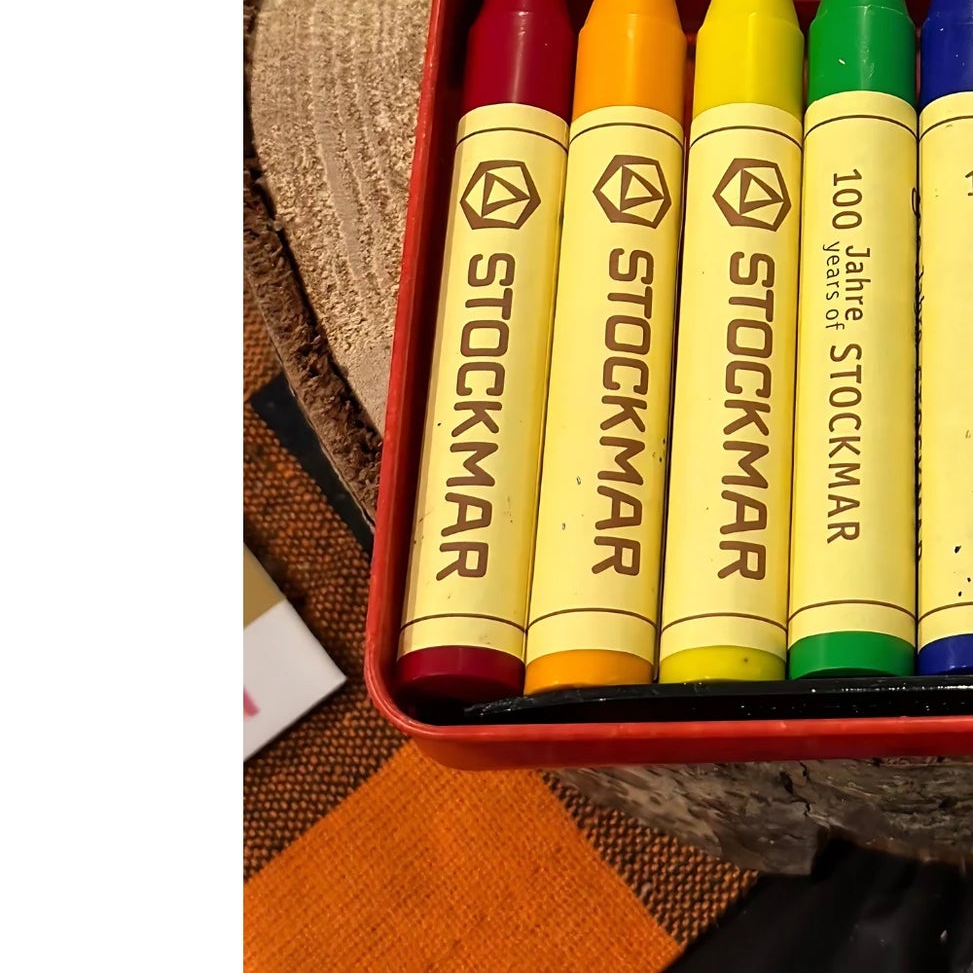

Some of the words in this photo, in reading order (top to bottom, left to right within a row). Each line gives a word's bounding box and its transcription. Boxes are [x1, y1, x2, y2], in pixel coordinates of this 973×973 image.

[831, 168, 863, 230] 100
[823, 240, 841, 301] years
[825, 308, 845, 331] of
[844, 245, 872, 321] Jahre
[435, 252, 516, 582] STOCKMAR
[591, 247, 654, 578] STOCKMAR
[718, 250, 776, 581] STOCKMAR
[826, 343, 863, 545] STOCKMAR
